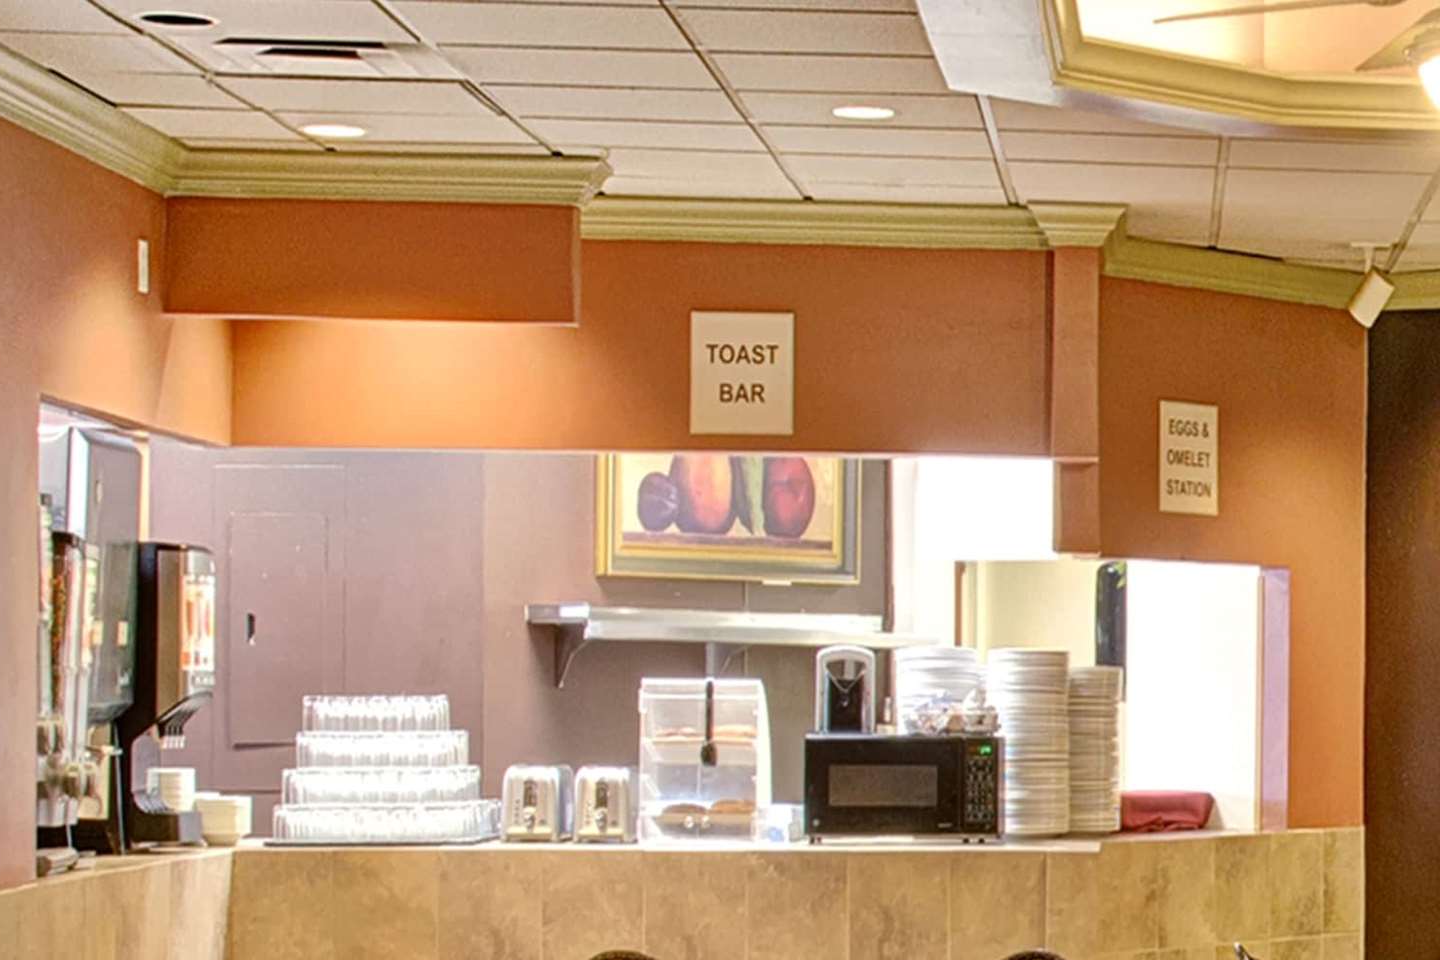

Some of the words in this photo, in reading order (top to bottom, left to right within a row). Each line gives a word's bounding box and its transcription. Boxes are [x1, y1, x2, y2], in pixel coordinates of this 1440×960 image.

[706, 344, 779, 364] TOAST
[719, 383, 765, 403] BAR
[1168, 418, 1199, 437] EGGS
[1202, 421, 1209, 438] &
[1166, 448, 1211, 468] OMELET
[1166, 479, 1212, 498] STATION
